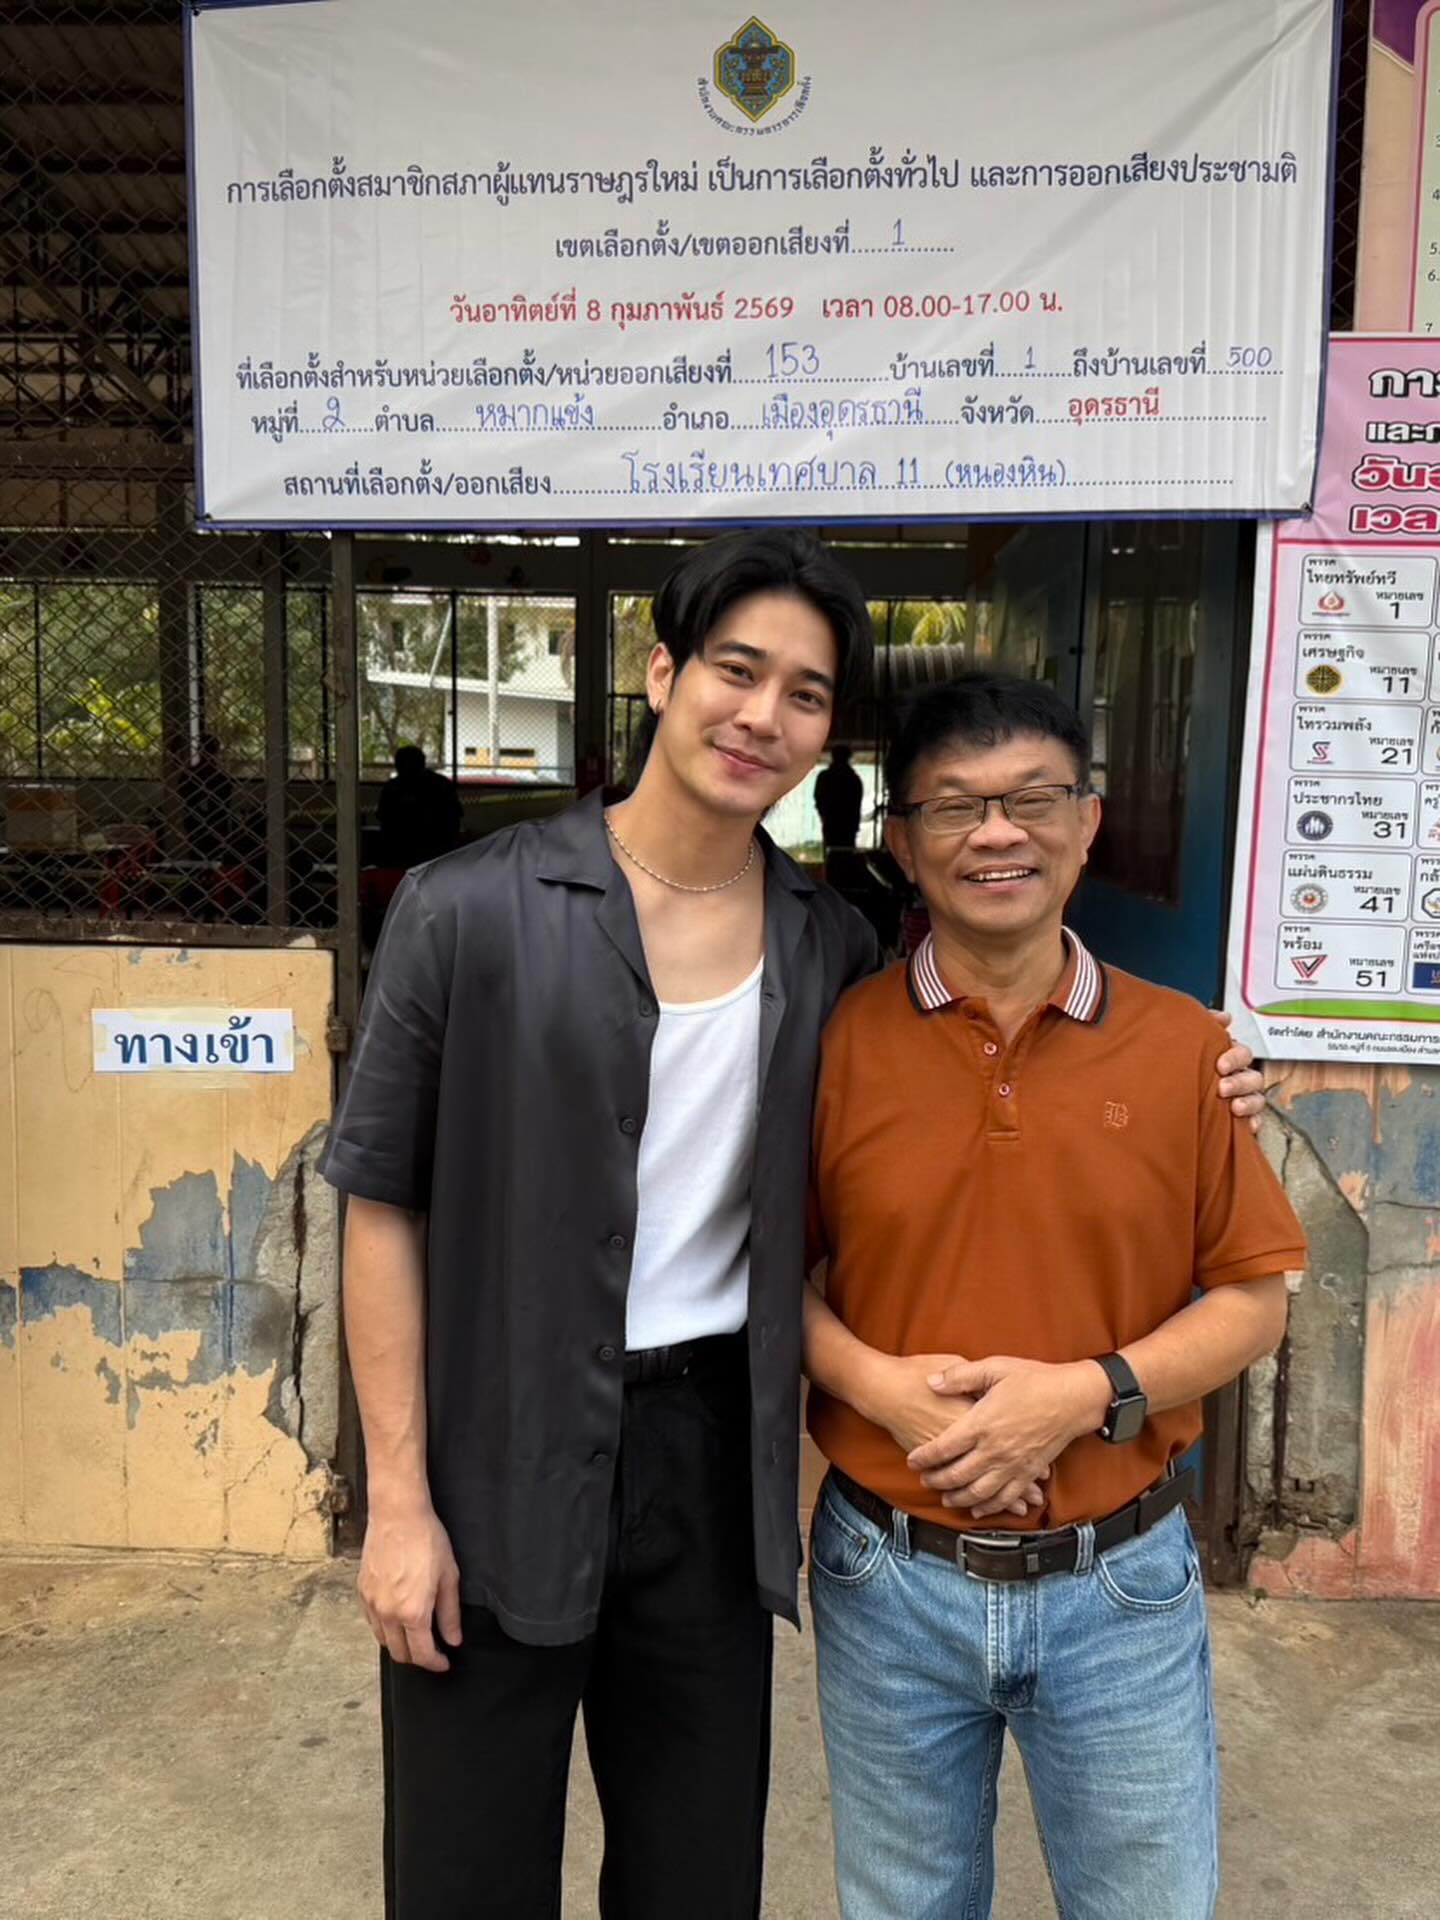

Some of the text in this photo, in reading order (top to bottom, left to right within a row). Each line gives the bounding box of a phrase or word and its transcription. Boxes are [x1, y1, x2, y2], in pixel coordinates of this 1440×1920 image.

[227, 147, 1297, 206] การเลือกตั้งสมาชิกสภาผู้แทนราษฎรใหม่ เป็นการเลือกตั้งทั่วไป และการออกเสียงประชามติ
[450, 287, 1064, 330] วันอาทิตย์ที่ 8 กุมภาพันธ์ 2569 เวลา 08.00-17.00 น.
[765, 341, 820, 379] 153
[889, 342, 996, 381] บ้านเลขที่
[1072, 341, 1207, 377] ถึงบ้านเลขที่
[1225, 345, 1274, 369] 500
[250, 386, 1160, 443] หมู่ที่ 2 ตำบล หมากแข้ง อำเภอ เมืองอุดรธานี จังหวัด อุดรธานี
[283, 448, 1067, 497] สถานที่เลือกตั้ง/ออกเสียง โรงเรียนเทศบาล 11 (หนองหิน)
[1389, 602, 1400, 620] 1
[1382, 676, 1410, 694] 11
[1381, 746, 1412, 766] 21
[1373, 820, 1406, 839] 31
[1359, 895, 1394, 914] 41
[1282, 935, 1323, 951] พร้อม
[1355, 969, 1387, 988] 51
[113, 1015, 275, 1064] ทางเข้า
